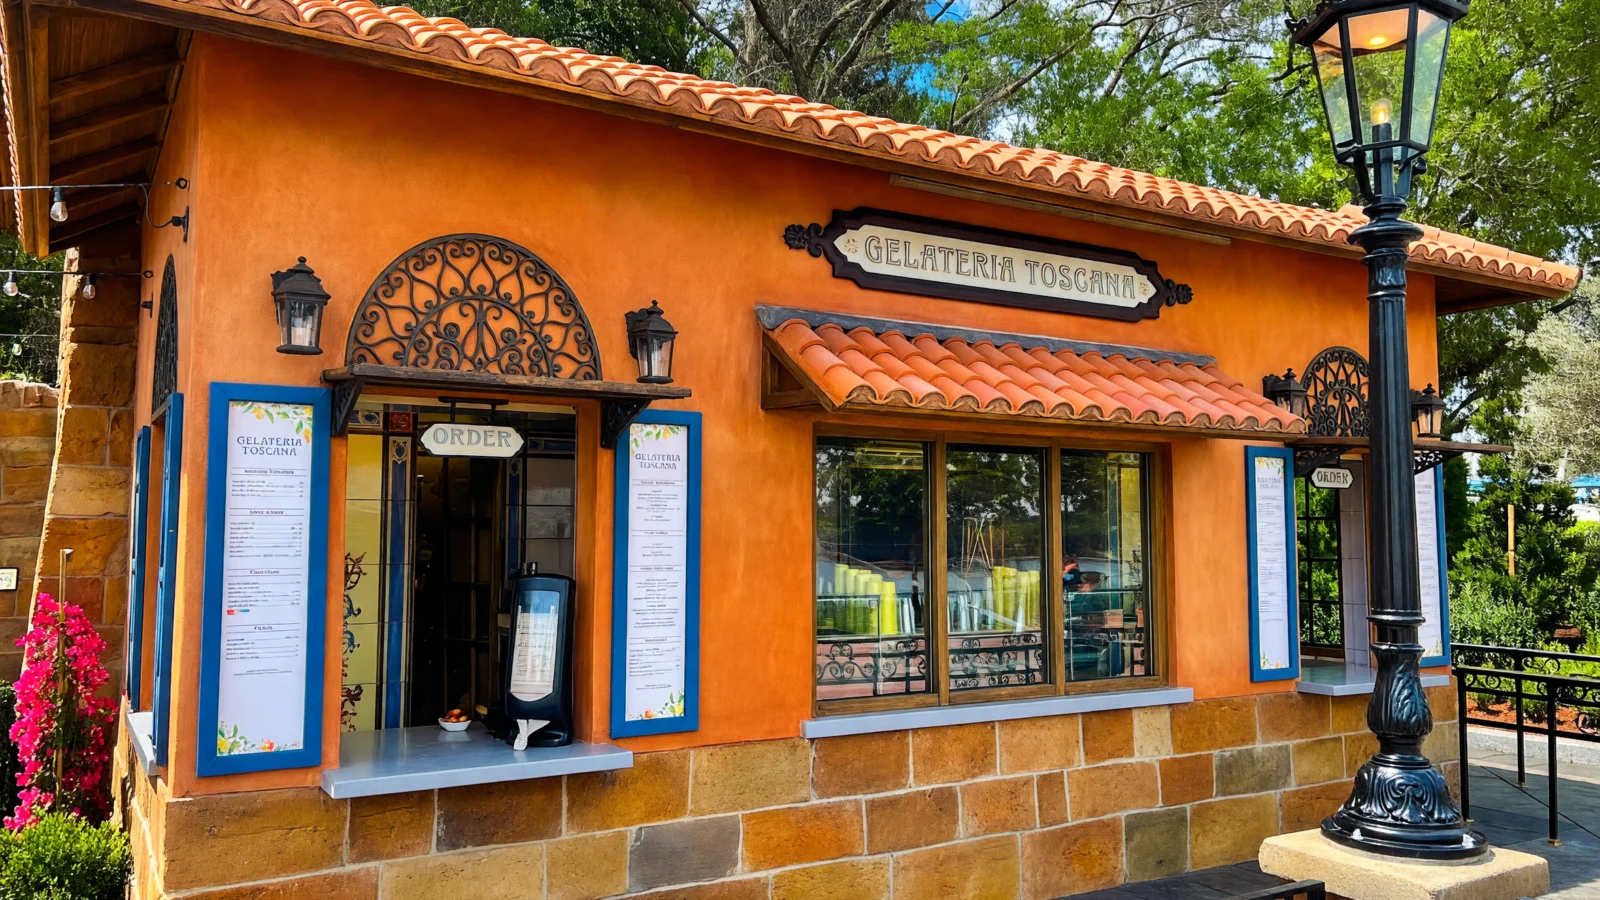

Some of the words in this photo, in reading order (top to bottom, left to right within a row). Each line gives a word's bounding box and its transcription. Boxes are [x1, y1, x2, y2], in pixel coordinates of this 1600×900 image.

[864, 234, 1017, 283] GELATERIA
[1024, 259, 1137, 300] TOSCANA
[236, 435, 303, 447] GELATERIA
[433, 427, 512, 448] ORDER
[241, 446, 297, 456] TOSCANA
[634, 453, 681, 462] GELATERIA
[639, 461, 677, 470] TOSCANA
[1316, 470, 1349, 484] ORDER
